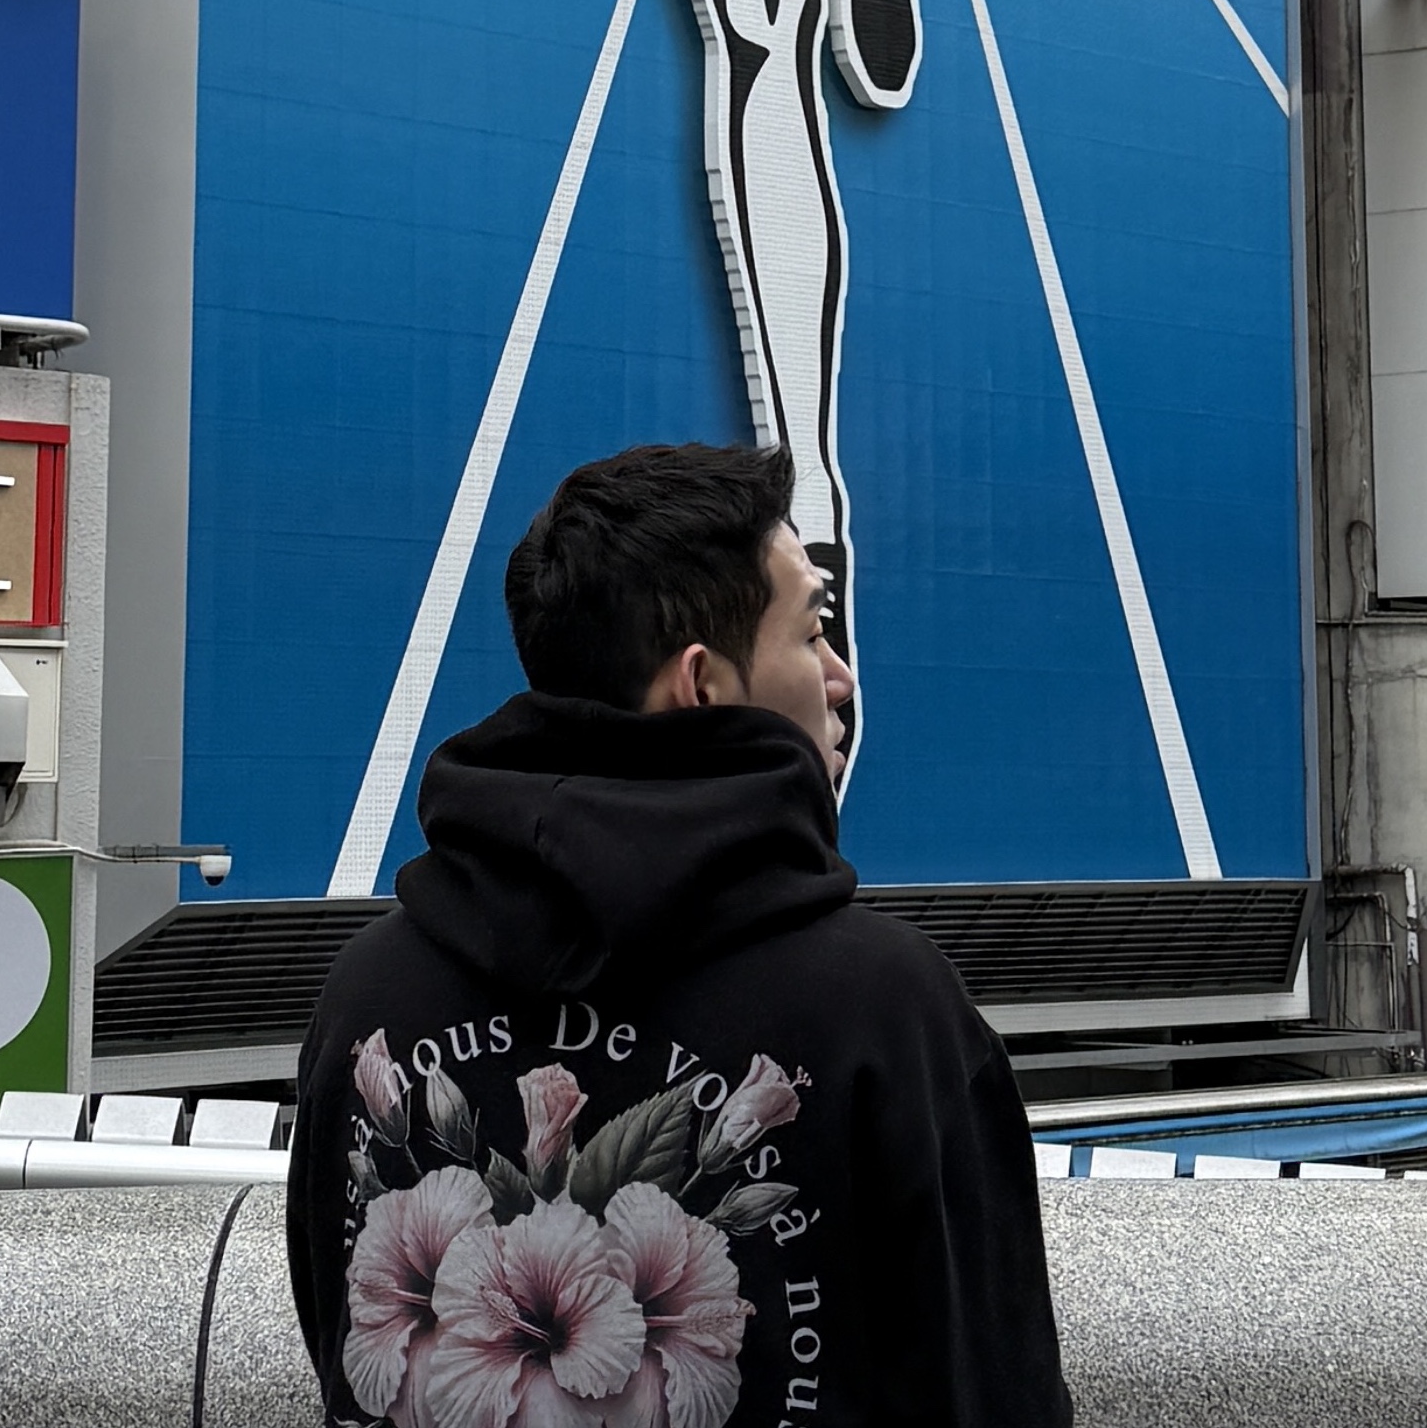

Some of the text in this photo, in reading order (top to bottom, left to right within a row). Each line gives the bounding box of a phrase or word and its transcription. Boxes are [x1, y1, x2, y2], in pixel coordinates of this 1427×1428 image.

[382, 1015, 513, 1108] nous
[549, 1001, 637, 1063] De
[769, 1208, 821, 1247] à
